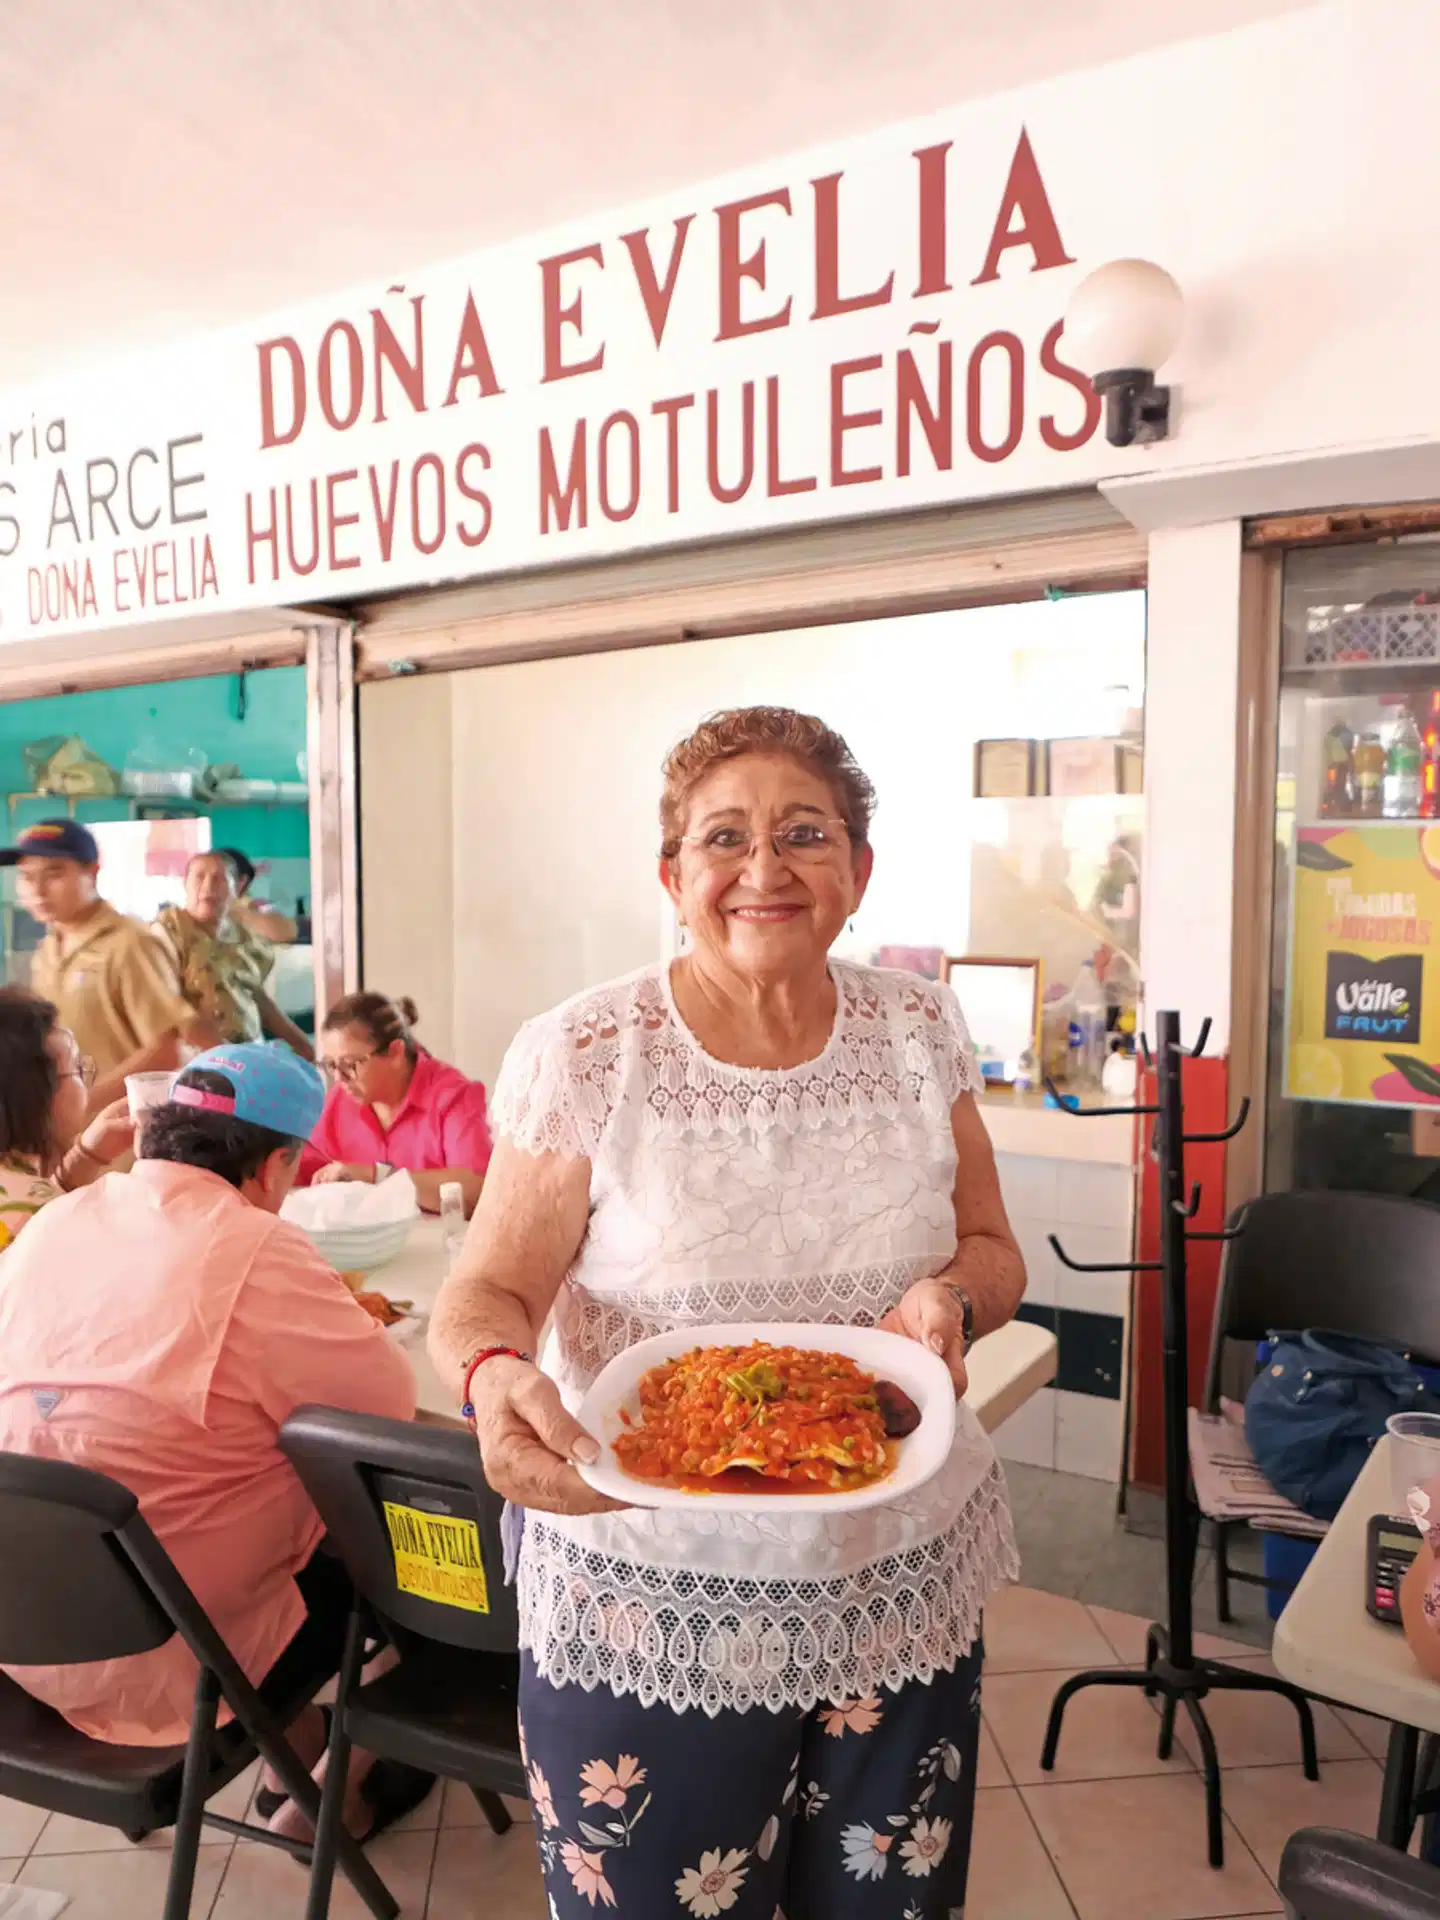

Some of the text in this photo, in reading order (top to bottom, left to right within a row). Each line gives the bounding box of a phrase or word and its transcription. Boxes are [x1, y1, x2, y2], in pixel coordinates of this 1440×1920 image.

[256, 121, 1077, 450] DOÑA EVELIA
[46, 431, 208, 549] ARCE
[245, 317, 1102, 585] HUEVOS MOTULEÑOS
[113, 532, 219, 612] EVELIA
[1335, 1015, 1409, 1034] FRUT
[1336, 980, 1408, 1014] Valle
[387, 1511, 480, 1569] DOÑA EVELIA
